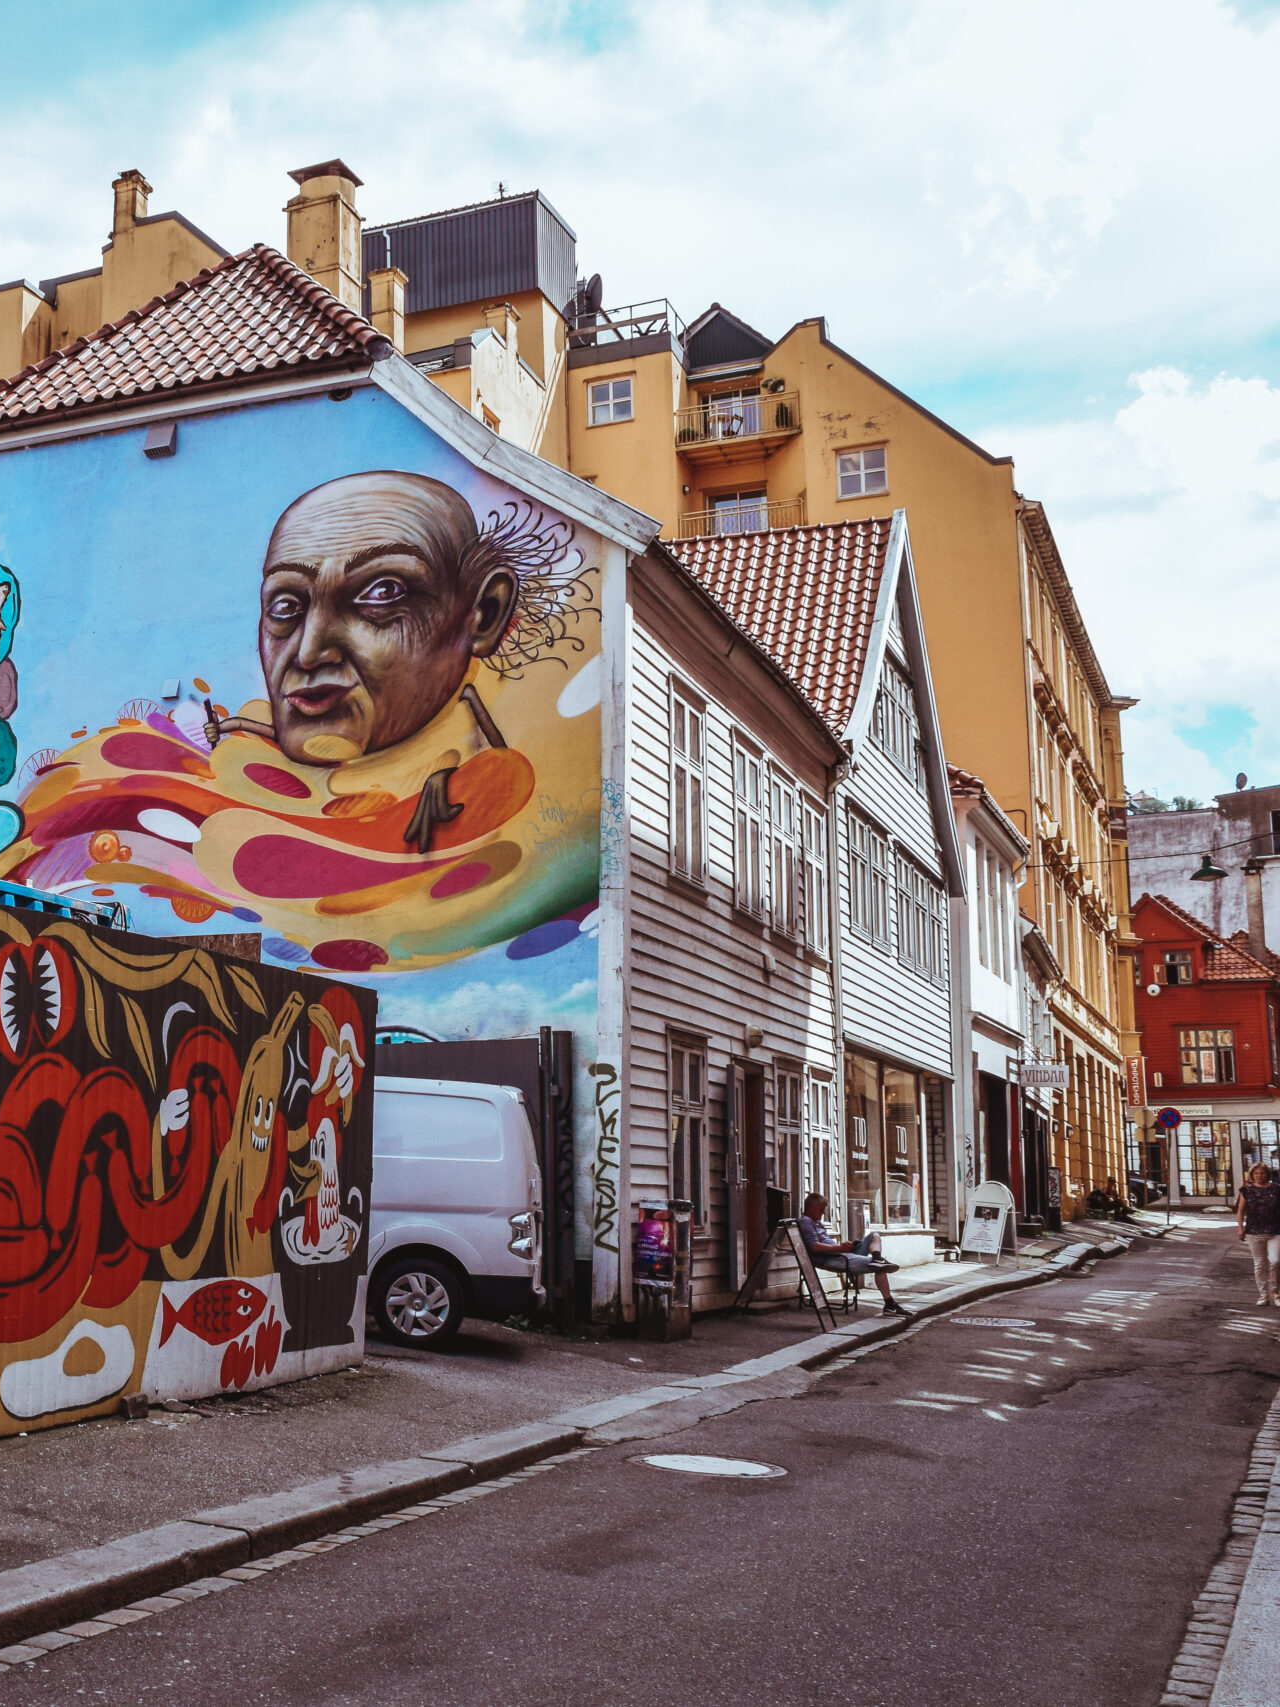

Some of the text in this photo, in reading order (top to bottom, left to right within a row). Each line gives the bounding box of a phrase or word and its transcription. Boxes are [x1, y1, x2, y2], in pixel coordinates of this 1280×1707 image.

[1024, 1069, 1066, 1083] VINBAR
[1130, 1059, 1140, 1105] TEMPOTEMPO
[853, 1116, 867, 1148] TID
[896, 1125, 908, 1154] TID
